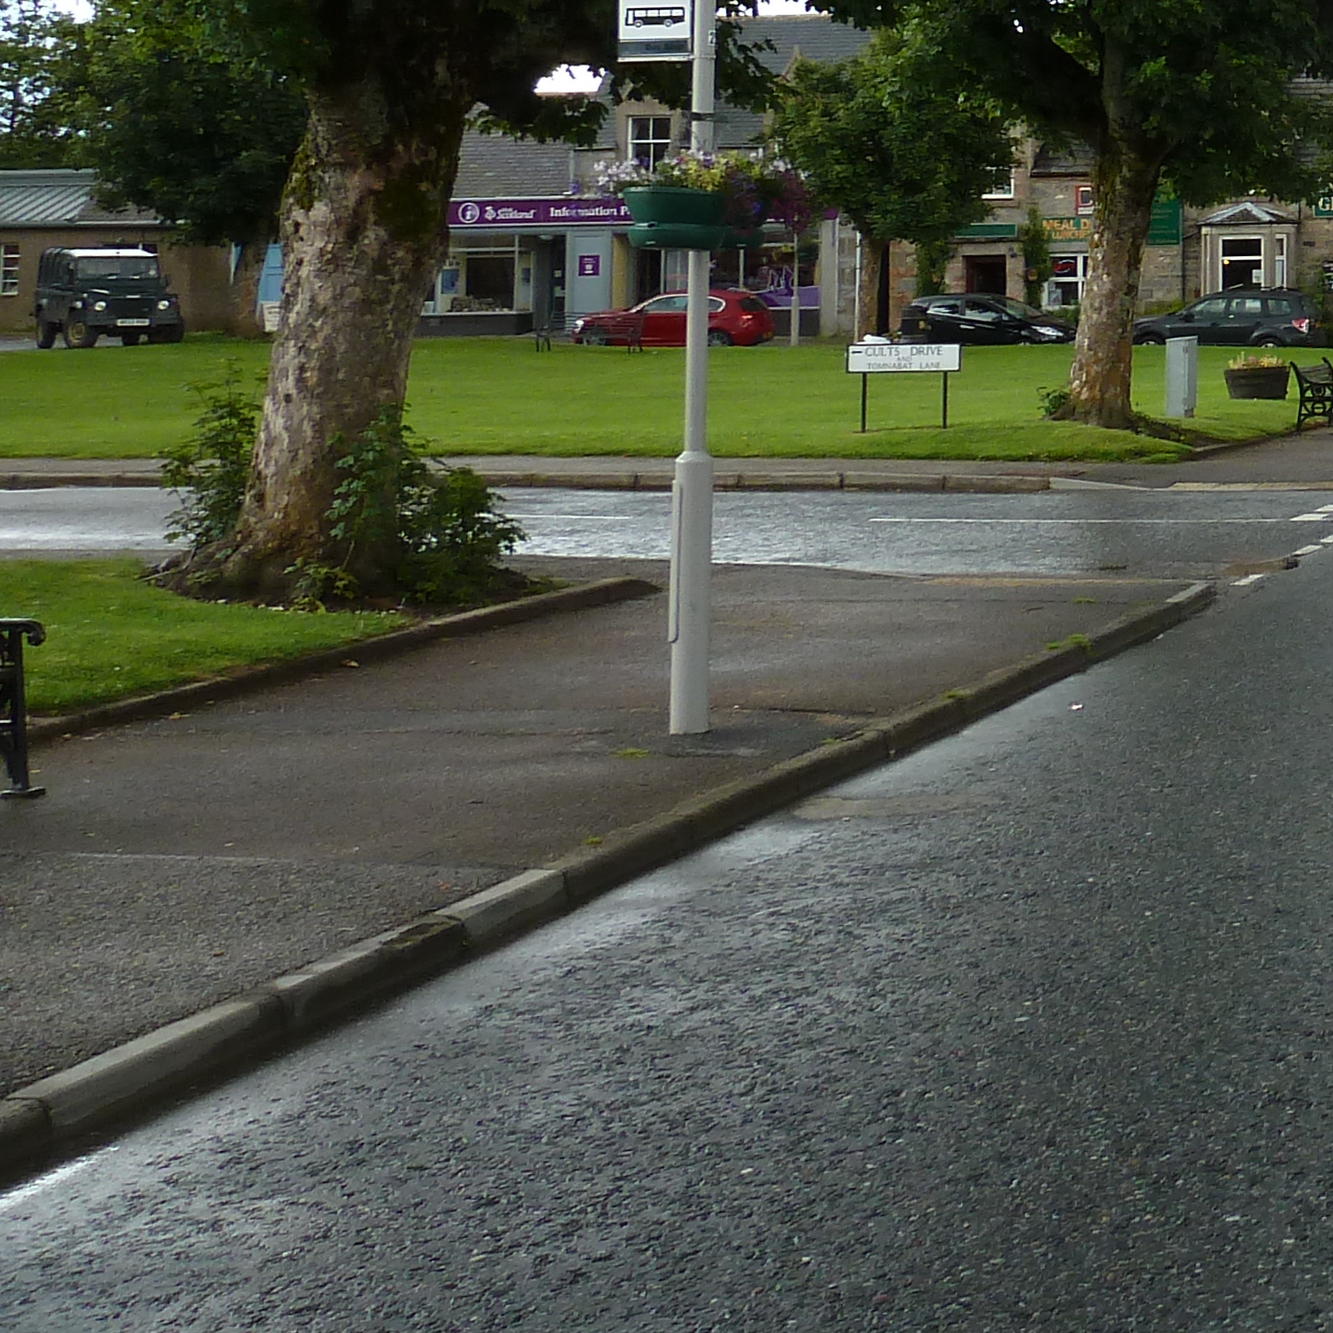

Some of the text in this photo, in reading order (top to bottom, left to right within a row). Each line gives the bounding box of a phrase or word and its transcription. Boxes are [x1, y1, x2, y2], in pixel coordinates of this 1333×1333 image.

[549, 206, 631, 217] Information P
[1080, 218, 1091, 230] D
[1052, 230, 1091, 240] LUNCHE
[865, 346, 944, 357] CULTS DRIVE
